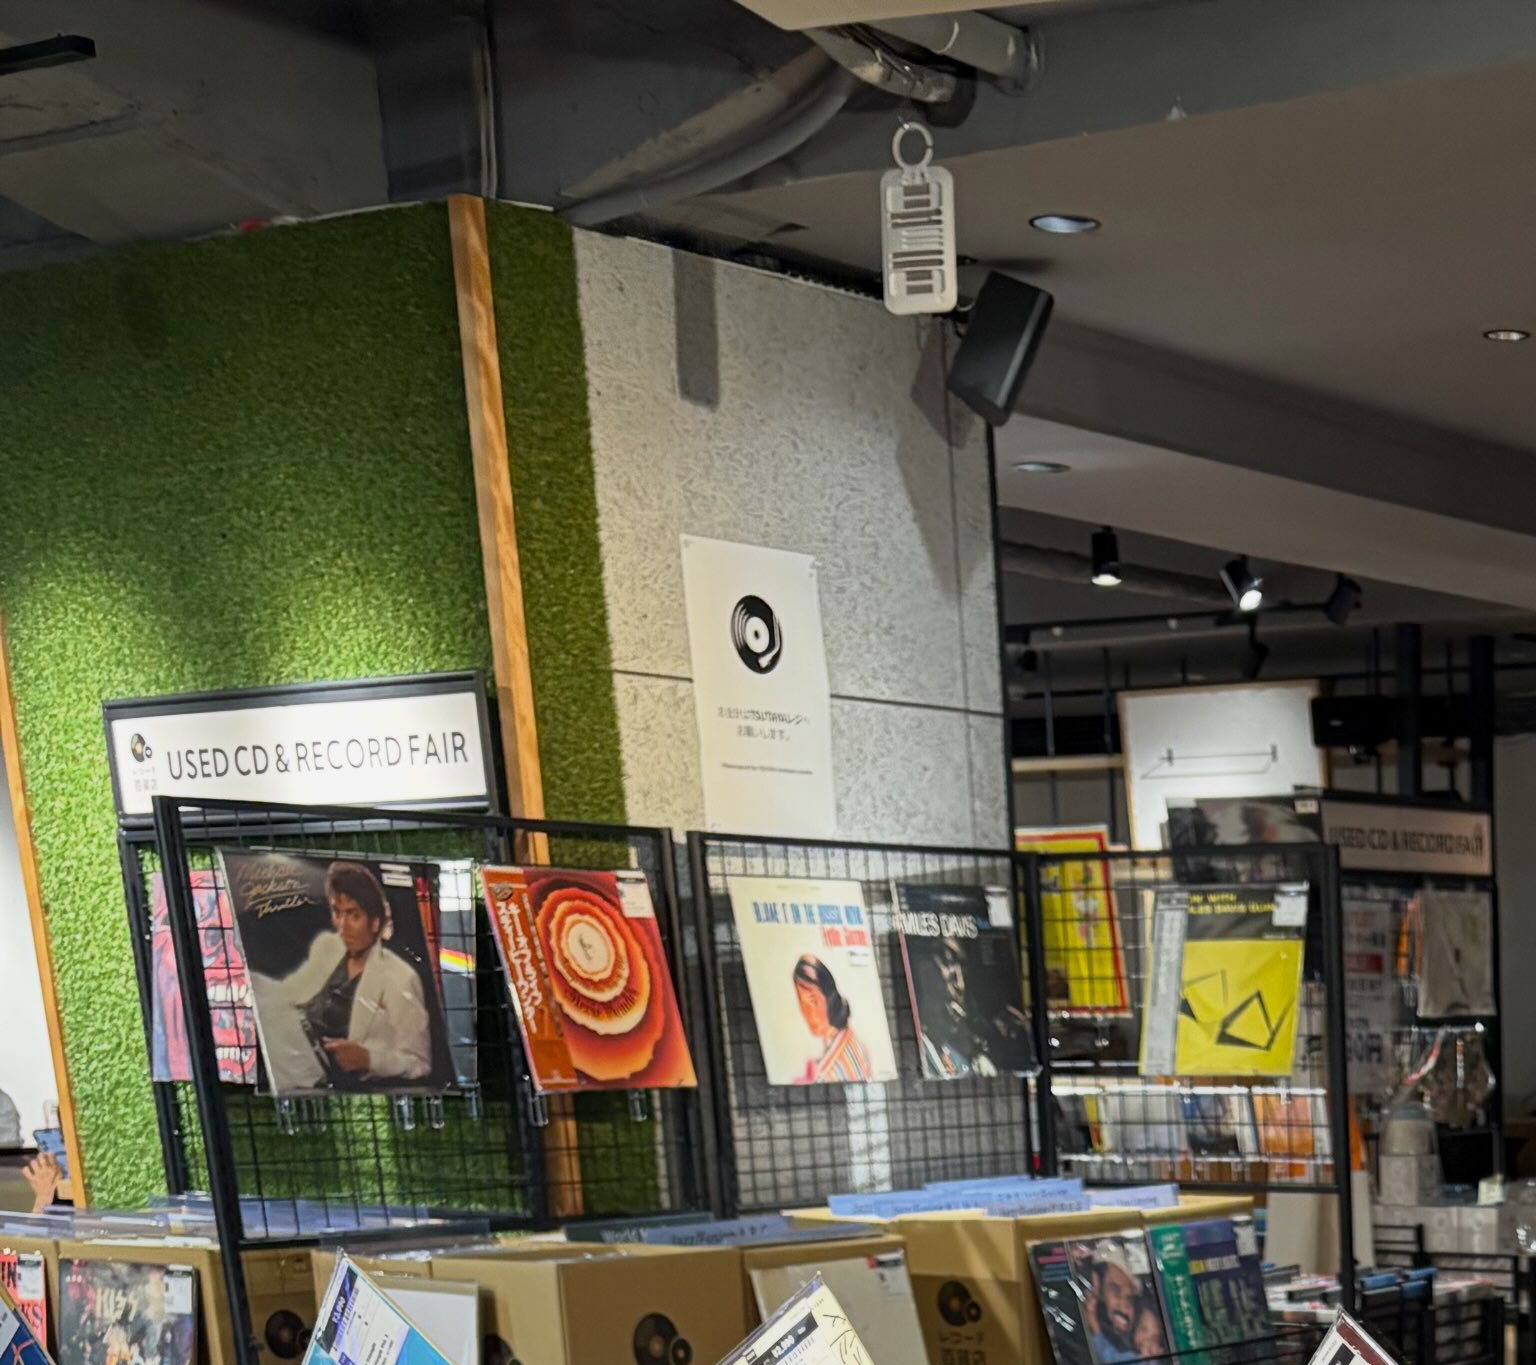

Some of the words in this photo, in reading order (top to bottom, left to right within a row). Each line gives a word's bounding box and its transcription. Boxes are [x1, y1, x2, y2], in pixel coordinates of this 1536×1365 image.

[167, 746, 229, 780] USED
[235, 744, 270, 777] CD
[276, 742, 291, 773] &
[295, 735, 402, 773] RECORD
[409, 730, 469, 766] FAIR
